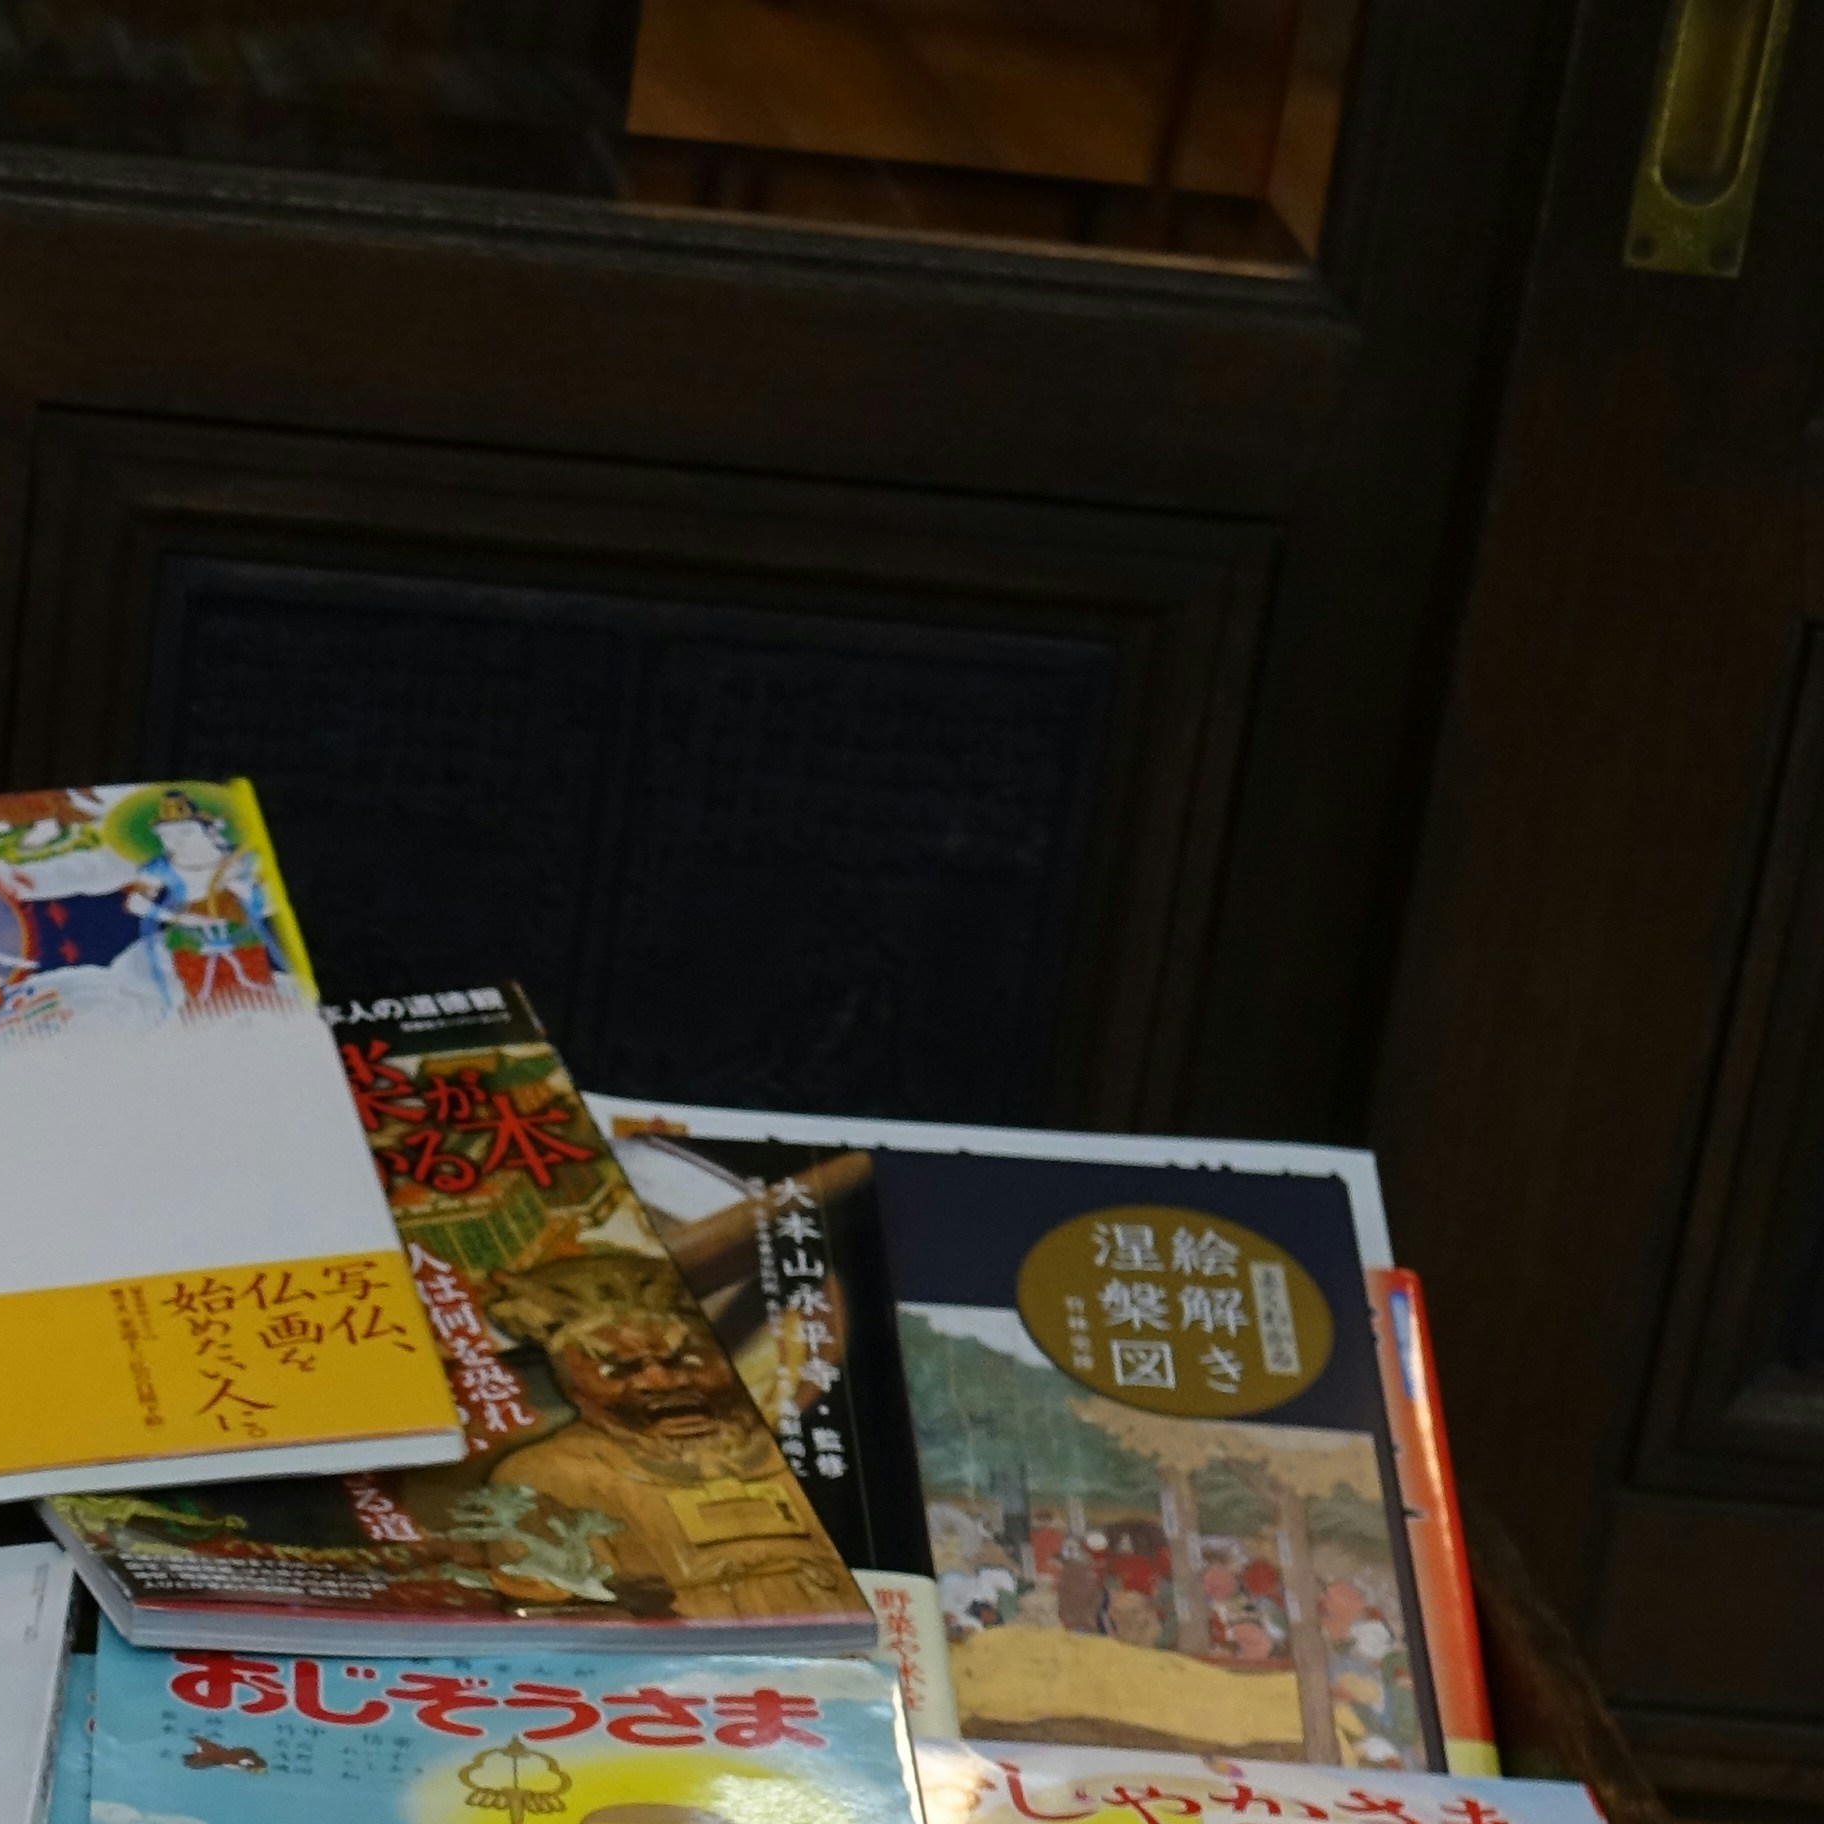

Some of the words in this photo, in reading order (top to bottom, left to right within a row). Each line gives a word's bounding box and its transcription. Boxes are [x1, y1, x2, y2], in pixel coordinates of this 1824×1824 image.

[1090, 1219, 1177, 1393] 涅槃図
[1169, 1225, 1252, 1396] 絵解き
[168, 1649, 834, 1749] おじぞうさま
